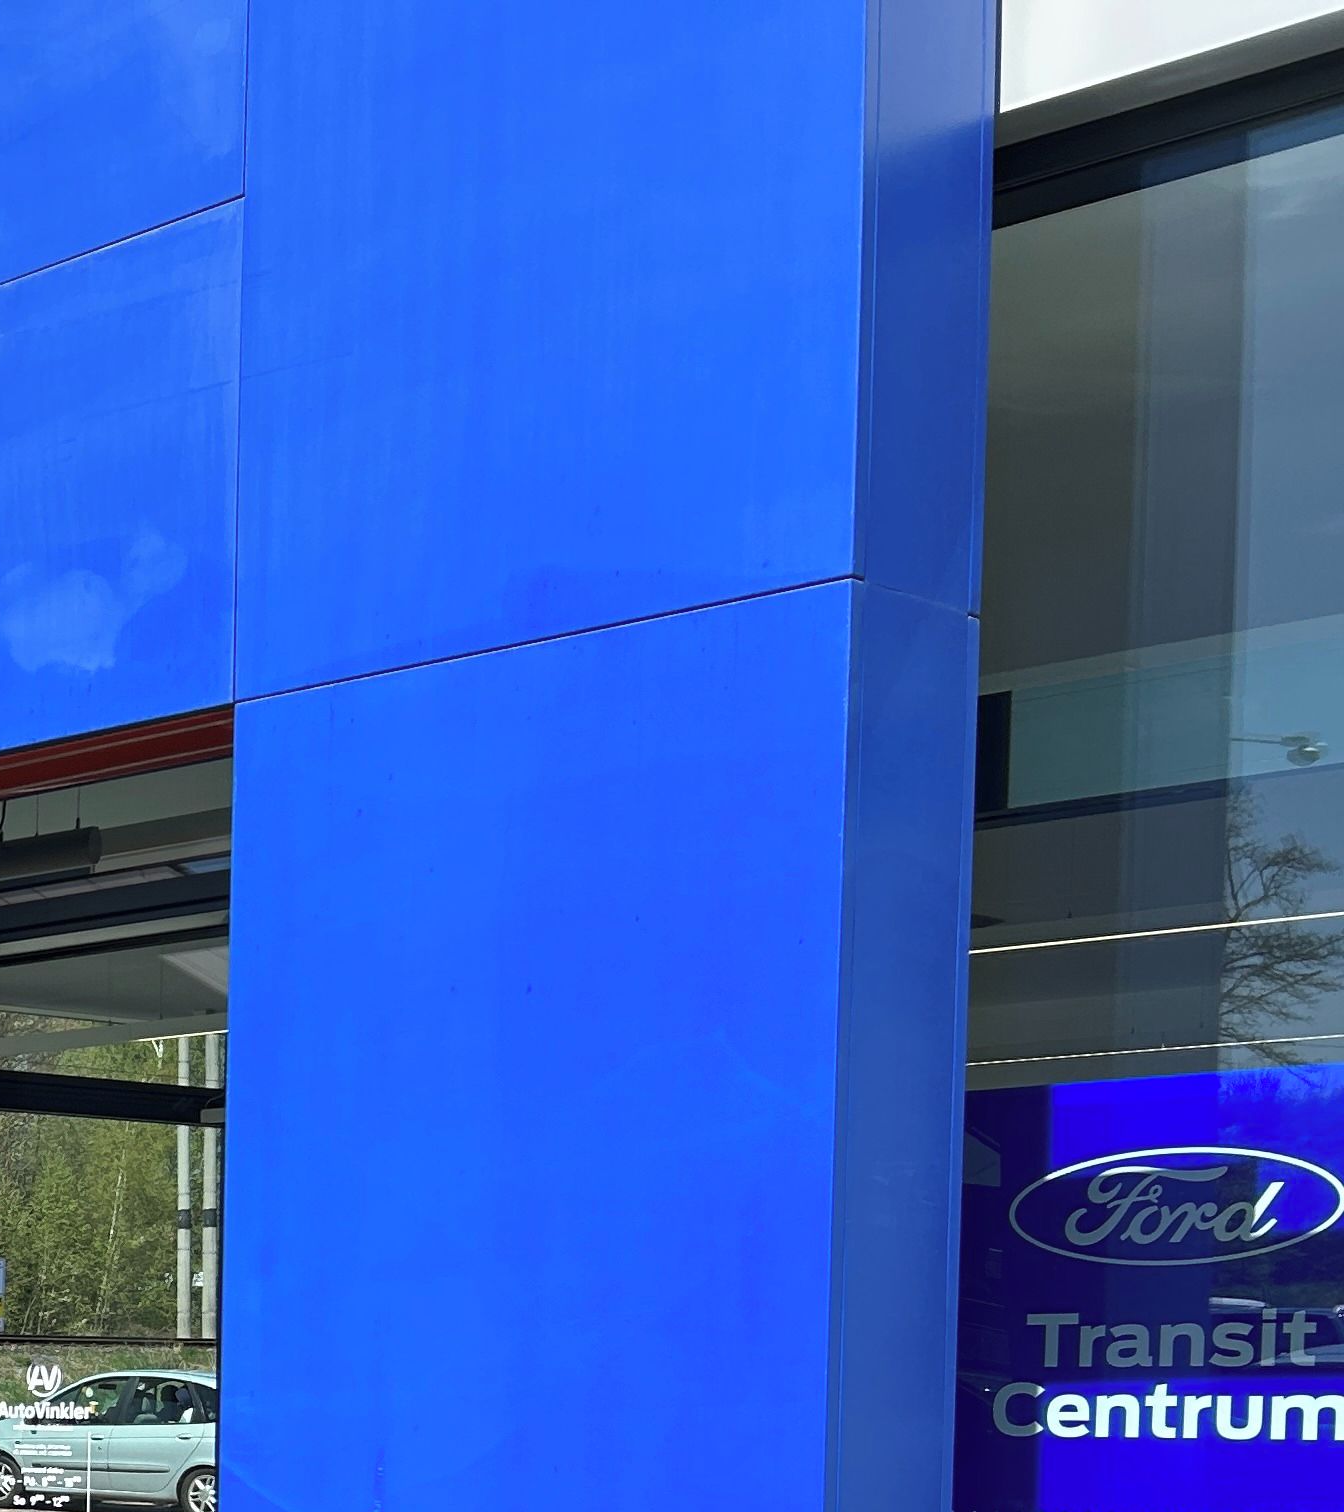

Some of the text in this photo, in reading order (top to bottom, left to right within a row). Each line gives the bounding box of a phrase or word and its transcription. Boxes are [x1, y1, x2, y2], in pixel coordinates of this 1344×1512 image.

[1064, 1165, 1285, 1246] Ford
[1027, 1308, 1317, 1369] Transit
[992, 1382, 1344, 1441] Centrum
